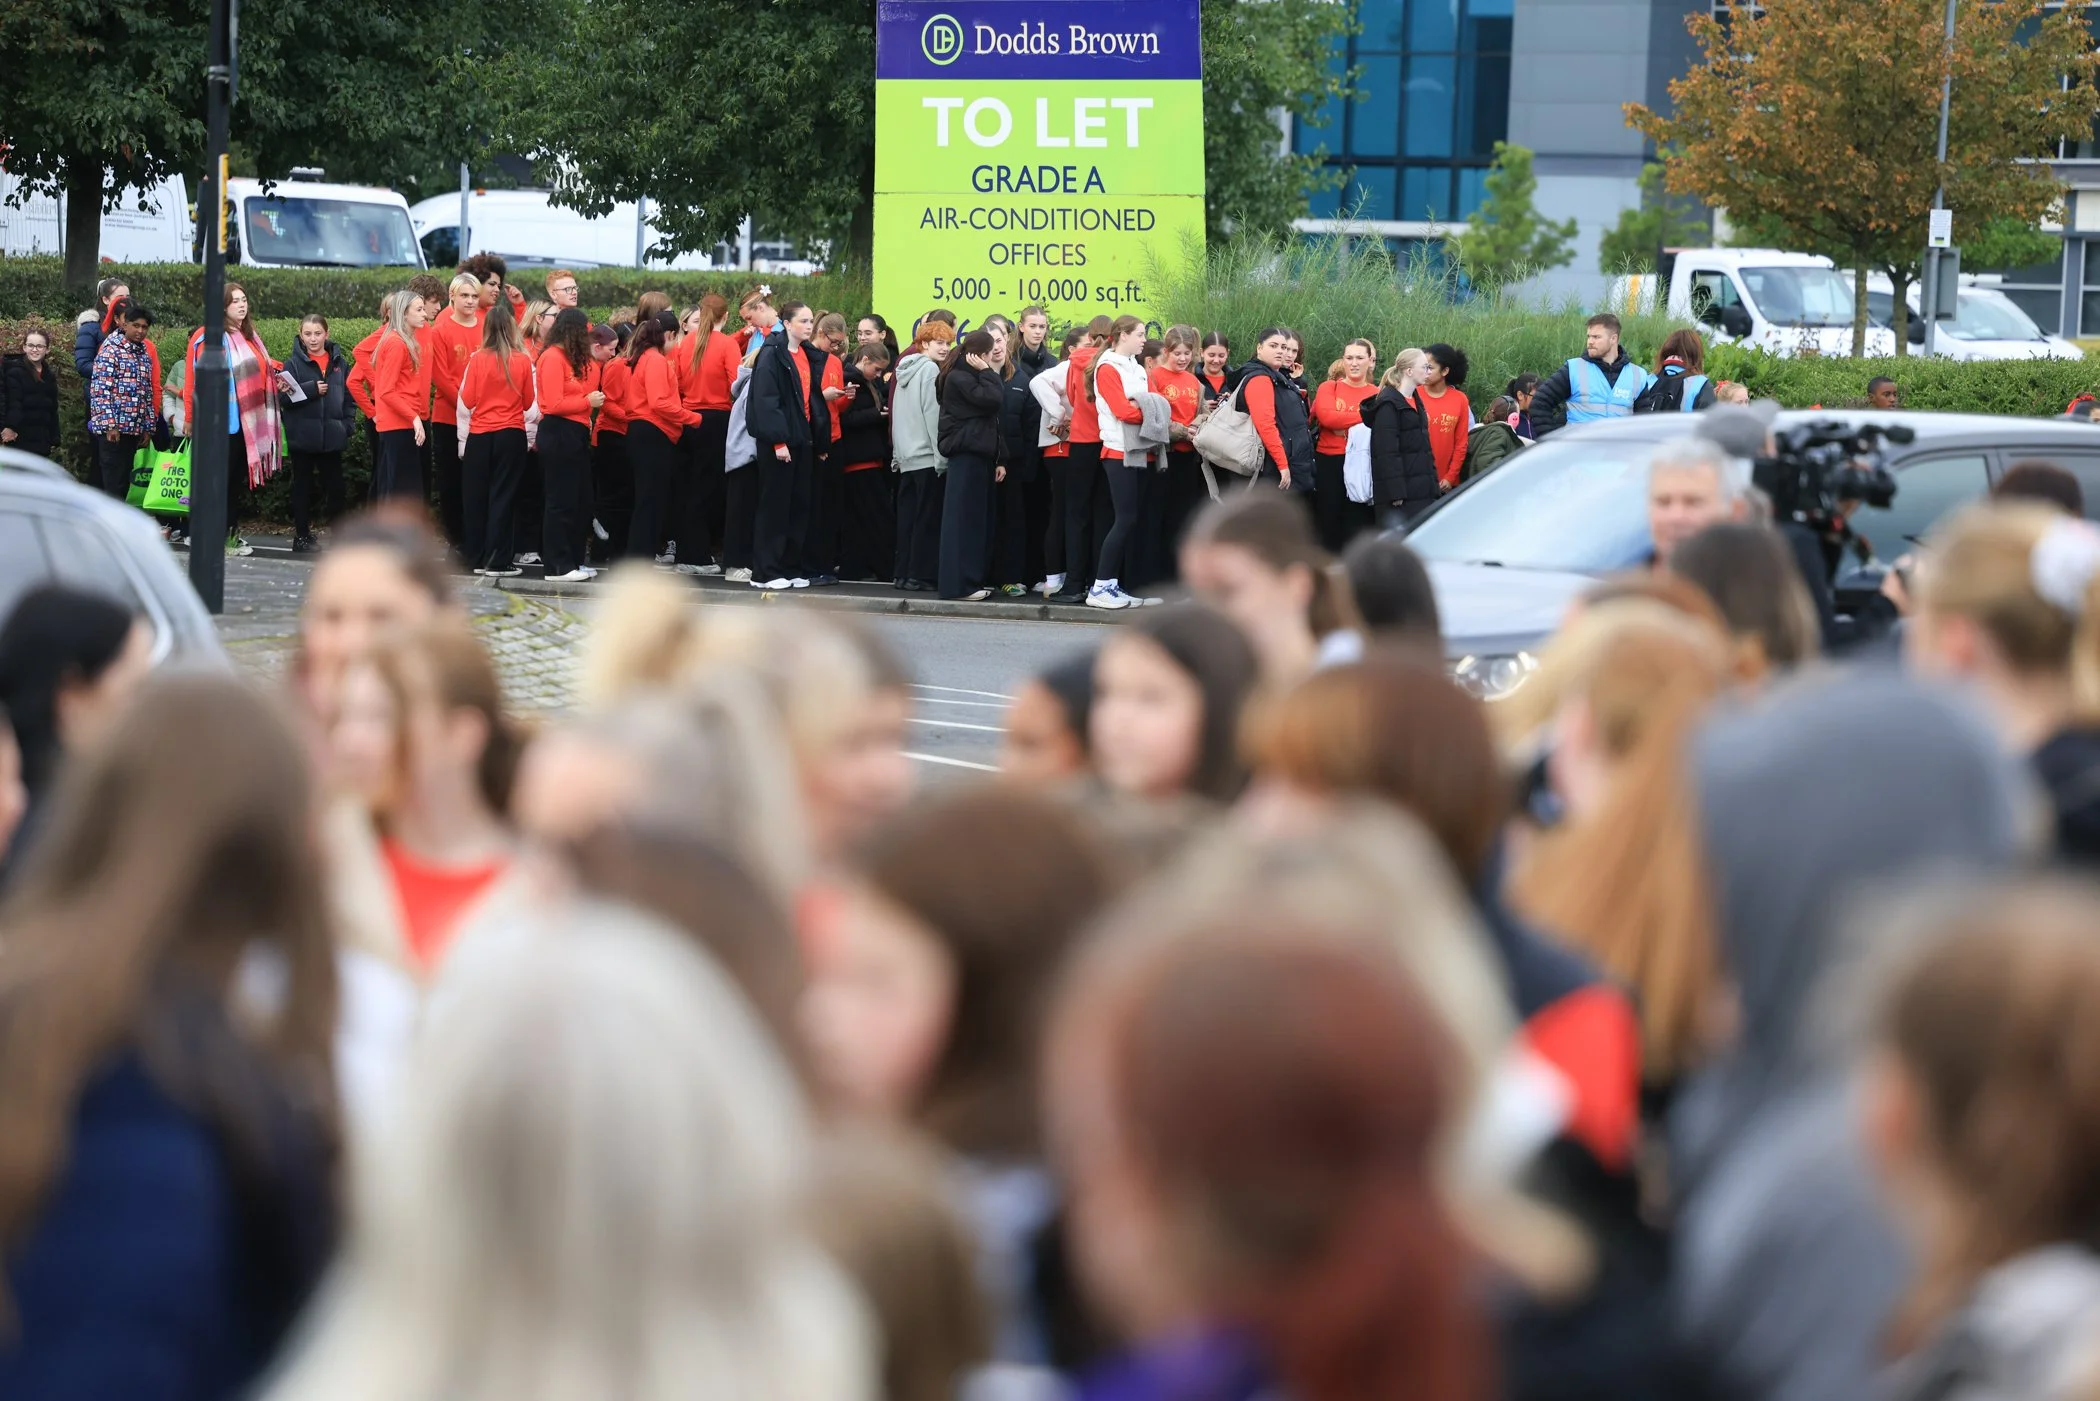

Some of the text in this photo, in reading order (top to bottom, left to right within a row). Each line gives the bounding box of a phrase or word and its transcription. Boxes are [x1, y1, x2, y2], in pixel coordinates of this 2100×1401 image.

[974, 22, 1160, 55] Dodds Brown
[921, 96, 1155, 148] TO LET
[971, 164, 1106, 194] GRADE A
[919, 207, 1156, 232] AIR-CONDITIONED
[988, 242, 1087, 267] OFFICES
[932, 277, 991, 303] 5,000
[1018, 278, 1088, 304] 10,000
[1095, 280, 1147, 309] sq.ft.
[134, 473, 152, 482] ASD
